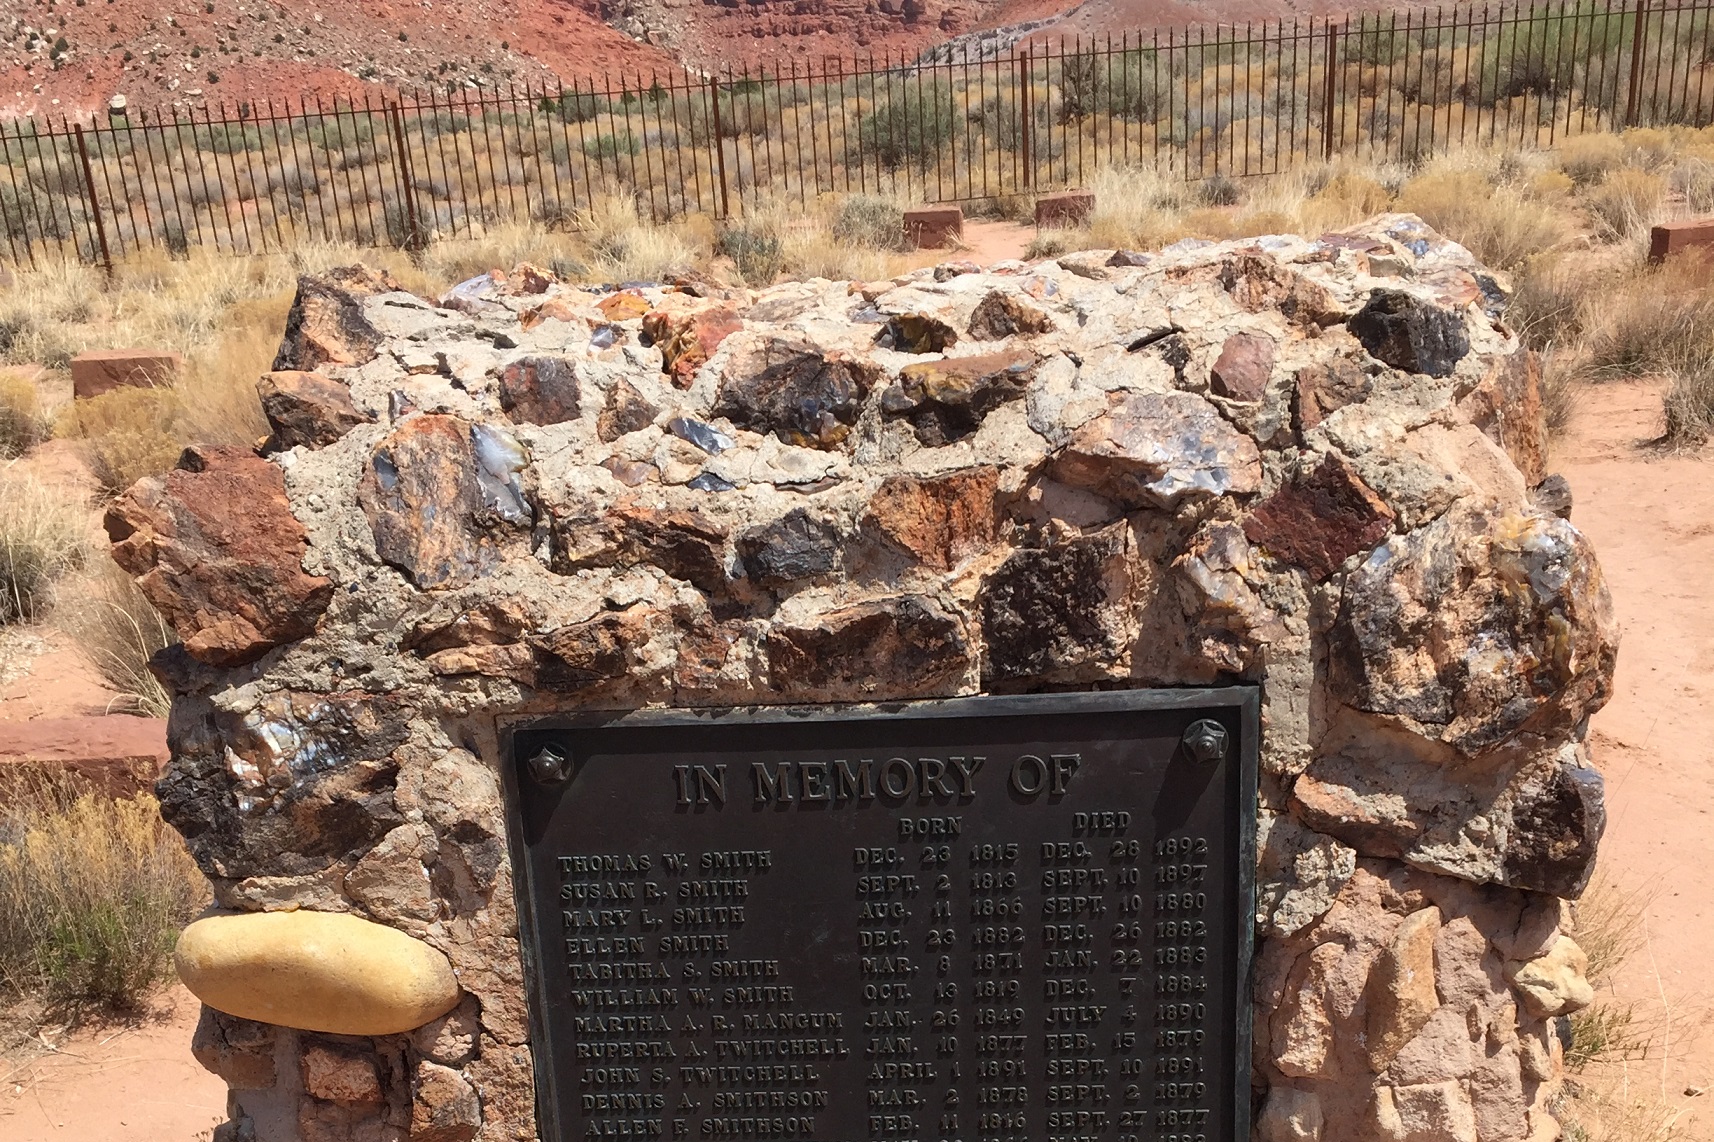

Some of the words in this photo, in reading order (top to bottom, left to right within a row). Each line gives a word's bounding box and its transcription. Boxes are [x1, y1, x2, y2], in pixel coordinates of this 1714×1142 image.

[675, 763, 727, 806] IN
[751, 757, 988, 803] MEMORY
[1010, 753, 1083, 797] OF
[900, 816, 962, 835] BORN
[1073, 811, 1132, 830] DIED
[558, 854, 651, 873] THOMAS
[663, 853, 688, 870] W.
[701, 850, 772, 869] SMITH
[855, 847, 905, 864] DEC.
[922, 846, 951, 862] 23
[970, 843, 1019, 861] 1815
[1042, 842, 1093, 859] DEC.
[1111, 839, 1140, 857] 28
[1155, 837, 1208, 856] 1892
[560, 882, 635, 900] SUSAN
[645, 882, 668, 898] R.
[679, 879, 748, 897] SMITH
[858, 875, 920, 893] SEPT.
[936, 874, 951, 891] 2
[971, 872, 1017, 889] 1813
[1043, 869, 1109, 888] SEPT.
[1118, 867, 1140, 884] 10
[1156, 864, 1208, 883] 1897
[563, 910, 631, 928] MARY
[640, 909, 663, 925] L.
[674, 906, 745, 924] SMITH
[858, 902, 912, 919] AUG.
[933, 901, 952, 917] 11
[972, 897, 1023, 916] 1866
[1043, 895, 1107, 914] SEPT.
[1121, 895, 1142, 912] 10
[1156, 893, 1207, 910] 1880
[566, 937, 644, 954] ELLEN
[660, 935, 729, 952] SMITH
[860, 930, 909, 948] DEC.
[927, 929, 956, 945] 23
[972, 927, 1025, 944] 1882
[1045, 925, 1094, 942] DEC.
[1112, 922, 1142, 940] 26
[1156, 920, 1206, 939] 1882
[568, 962, 671, 980] TABITHA
[683, 962, 701, 978] S.
[711, 960, 779, 977] SMITH
[862, 956, 919, 973] MAR.
[939, 955, 951, 972] 8
[973, 952, 1023, 970] 1871
[1044, 950, 1098, 967] JAN.
[1112, 948, 1142, 966] 22
[1156, 946, 1207, 965] 1883
[571, 988, 678, 1006] WILLIAM
[689, 987, 714, 1003] W.
[724, 986, 794, 1003] SMITH
[864, 983, 912, 1000] OCT.
[935, 982, 958, 998] 13
[975, 980, 1020, 998] 1819
[1046, 978, 1096, 997] DEC.
[1118, 977, 1137, 994] 7
[1156, 975, 1208, 992] 1884
[575, 1016, 671, 1033] MARTHA
[681, 1015, 704, 1031] A.
[712, 1015, 735, 1030] R.
[744, 1013, 842, 1029] MANGUM
[864, 1011, 920, 1028] JAN.
[933, 1010, 959, 1026] 26
[975, 1007, 1025, 1025] 1849
[1046, 1006, 1107, 1024] JULY
[1122, 1005, 1137, 1021] 4
[1156, 1003, 1207, 1020] 1890
[576, 1042, 676, 1059] RUPERTA
[685, 1042, 708, 1057] A.
[715, 1039, 850, 1057] TWITCHELL
[866, 1037, 919, 1055] JAN.
[938, 1036, 958, 1053] 10
[977, 1036, 1028, 1052] 1877
[1046, 1033, 1096, 1050] FEB.
[1114, 1033, 1136, 1049] 15
[1156, 1029, 1206, 1048] 1879
[581, 1068, 639, 1085] JOHN
[651, 1068, 671, 1083] S.
[679, 1065, 819, 1083] TWITCHELL
[867, 1062, 938, 1080] APRIL
[952, 1062, 961, 1078] 1
[978, 1059, 1026, 1078] 1891
[1046, 1059, 1109, 1076] SEPT.
[1120, 1058, 1143, 1075] 10
[1156, 1056, 1204, 1073] 1891
[582, 1094, 665, 1110] DENNIS
[678, 1093, 701, 1109] A.
[713, 1091, 828, 1108] SMITHSON
[868, 1090, 927, 1106] MAR.
[945, 1088, 959, 1104] 2
[978, 1087, 1028, 1104] 1878
[1046, 1084, 1111, 1102] SEPT.
[1125, 1084, 1140, 1101] 2
[1155, 1082, 1207, 1100] 1879
[585, 1119, 662, 1136] ALLEN
[673, 1119, 689, 1134] F.
[701, 1117, 815, 1134] SMITHSON
[870, 1115, 920, 1132] FEB.
[941, 1114, 958, 1131] 11
[1048, 1111, 1110, 1128] SEPT.
[1119, 1110, 1147, 1126] 27
[1156, 1109, 1210, 1126] 1877
